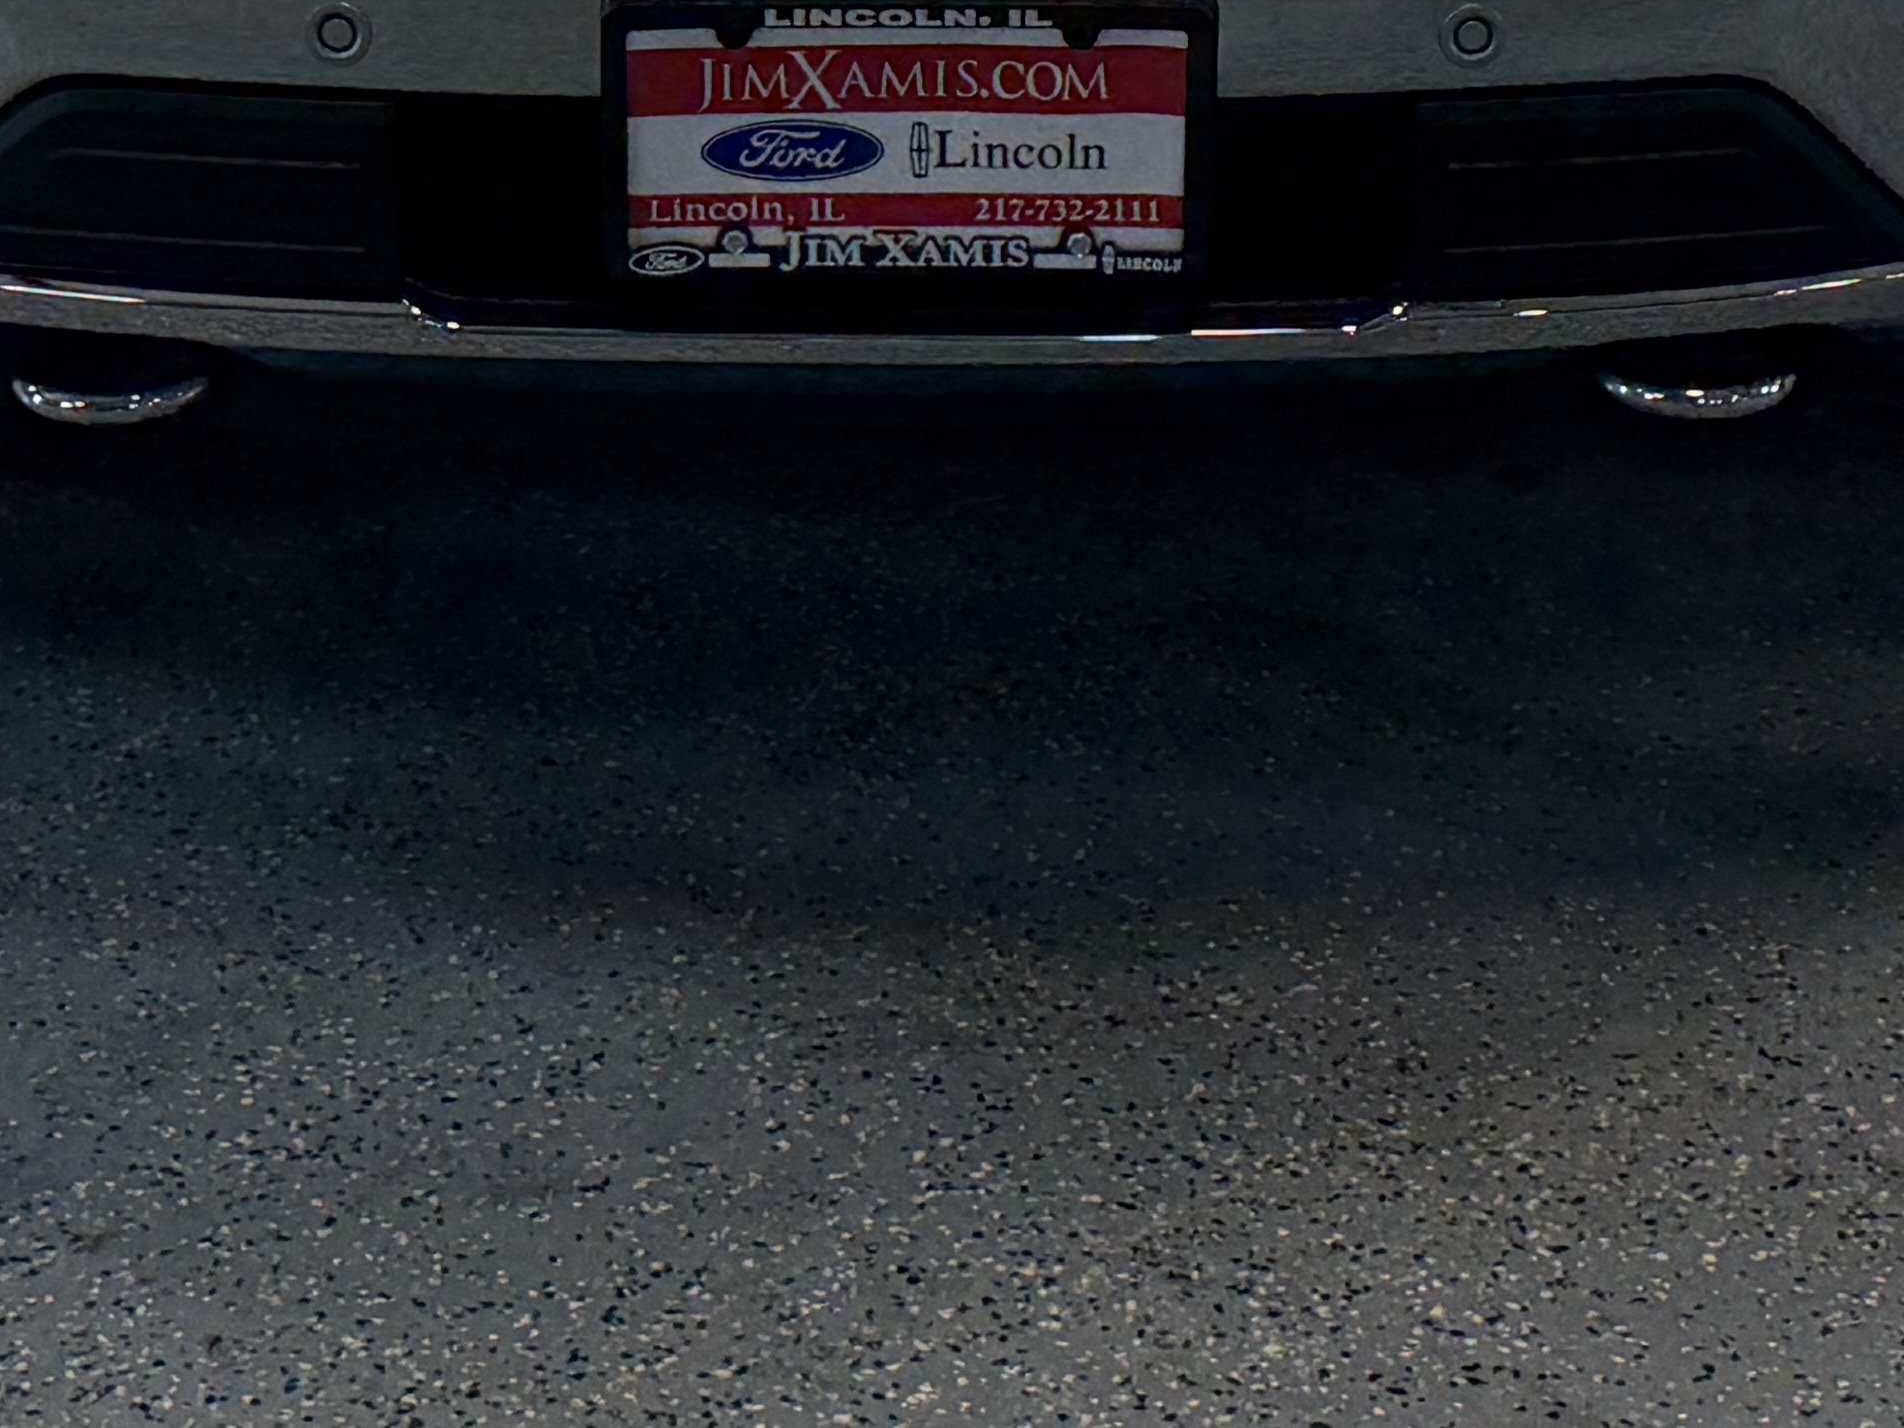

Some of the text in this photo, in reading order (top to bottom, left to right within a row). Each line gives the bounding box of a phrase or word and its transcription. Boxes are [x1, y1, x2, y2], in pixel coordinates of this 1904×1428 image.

[1008, 9, 1053, 27] IL
[699, 49, 1110, 111] JIMXAMIS.COM
[738, 129, 847, 170] Ford
[934, 132, 1108, 171] Lincoln
[648, 197, 846, 225] Lincoln, IL
[974, 197, 1161, 223] 217-732-2111
[779, 230, 1031, 272] JIM XAMIS
